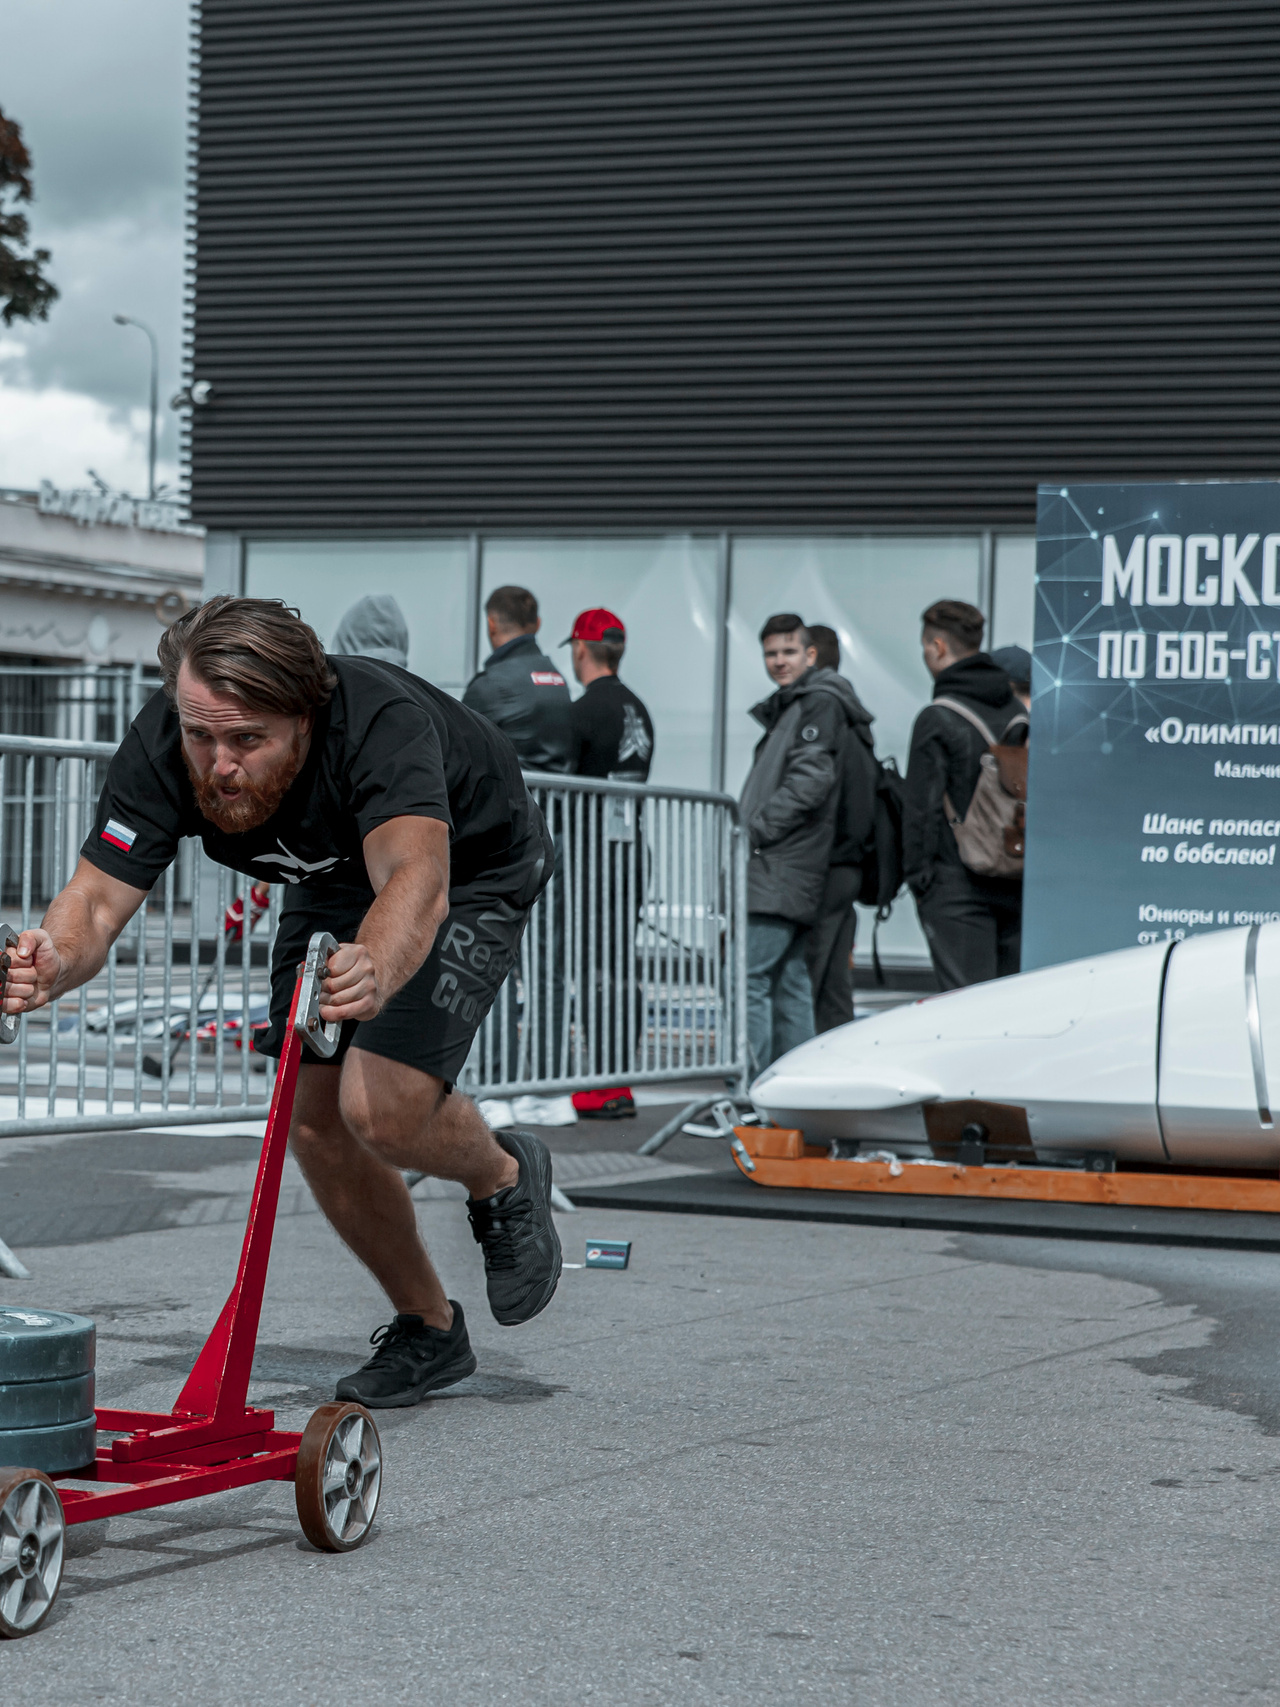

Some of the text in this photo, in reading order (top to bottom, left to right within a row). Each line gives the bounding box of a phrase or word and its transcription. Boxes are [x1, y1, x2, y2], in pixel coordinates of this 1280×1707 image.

[1097, 631, 1146, 679] ПО
[1144, 717, 1280, 745] «Олимпи
[1142, 813, 1205, 835] Шанс
[1141, 841, 1276, 866] по бобслею!
[1138, 904, 1214, 928] Юниоры
[1217, 910, 1230, 925] и
[1137, 930, 1159, 945] от
